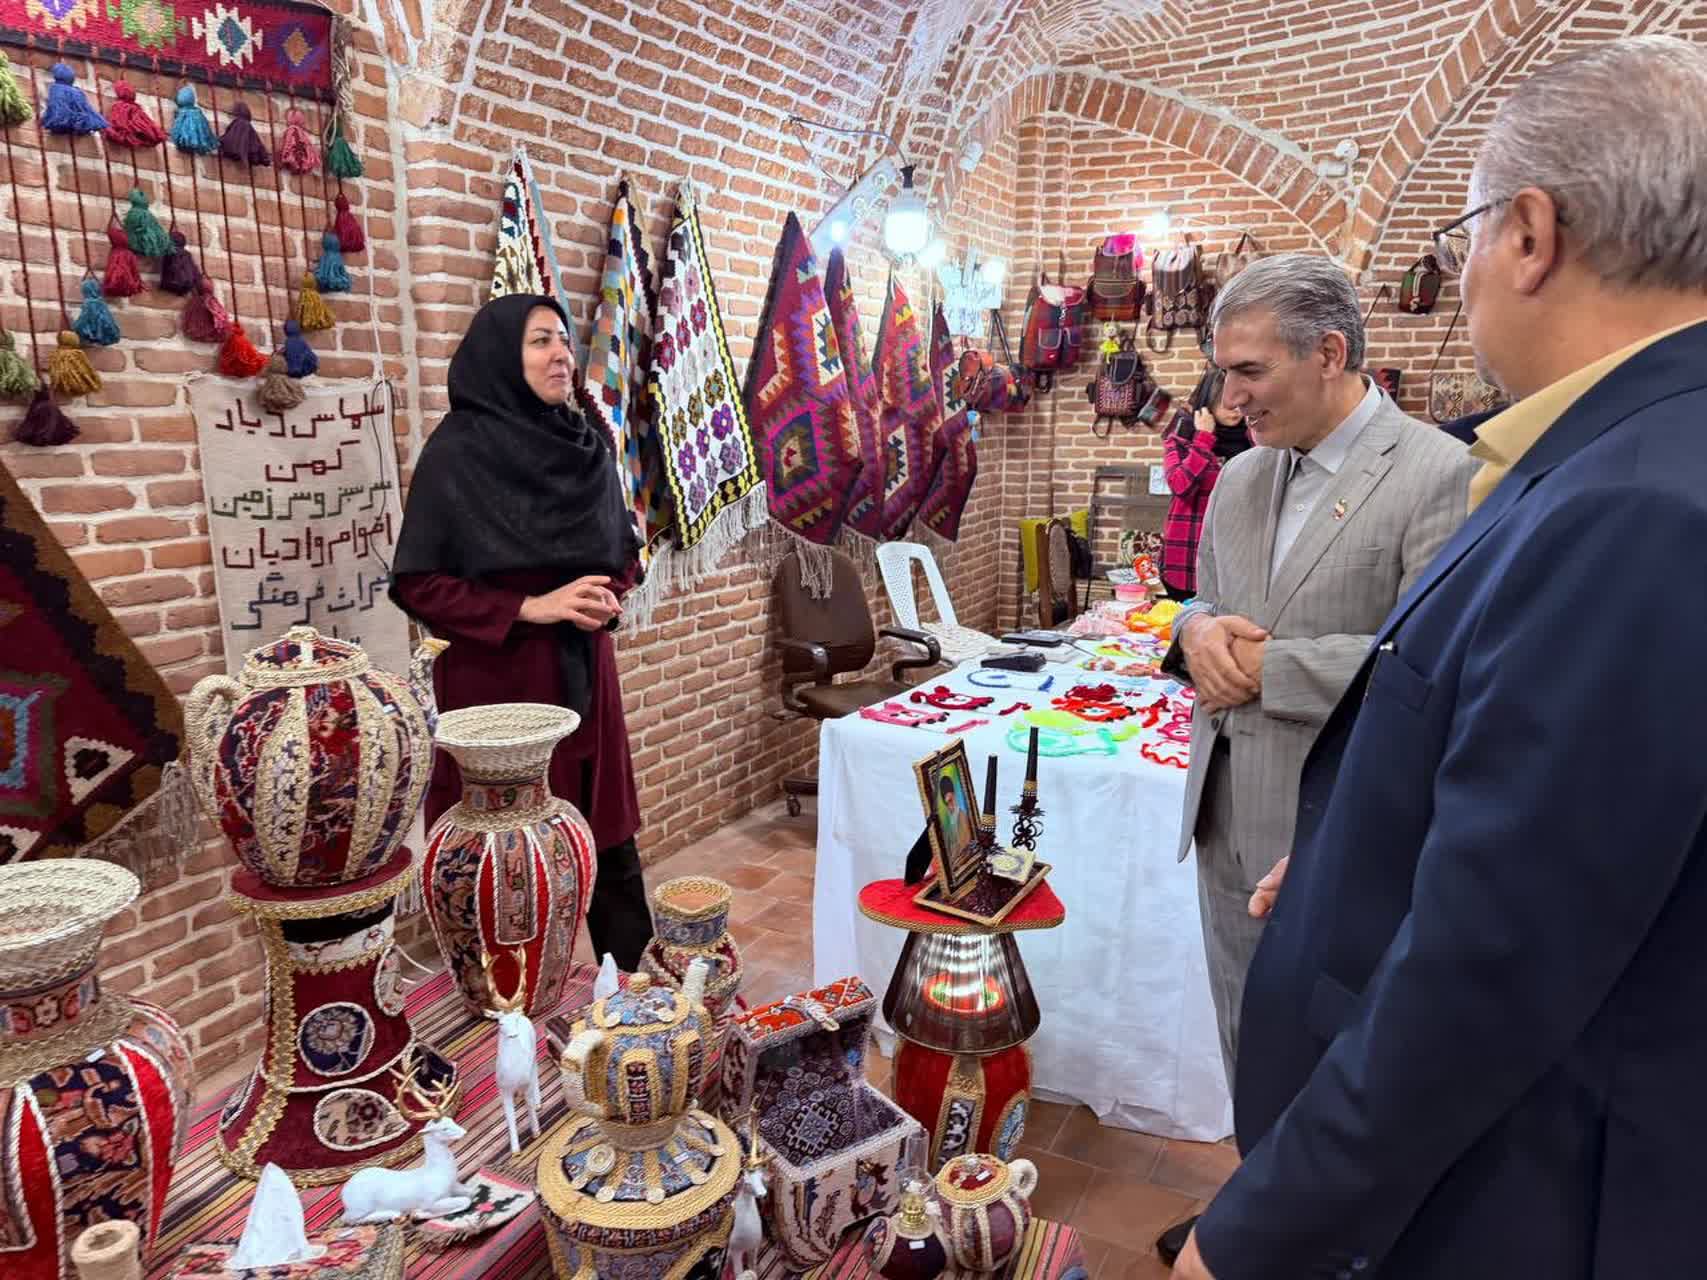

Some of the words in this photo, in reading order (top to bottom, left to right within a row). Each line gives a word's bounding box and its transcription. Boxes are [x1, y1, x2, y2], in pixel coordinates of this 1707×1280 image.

[291, 394, 385, 438] سلماس
[265, 440, 360, 482] کهن
[328, 572, 392, 612] یراث
